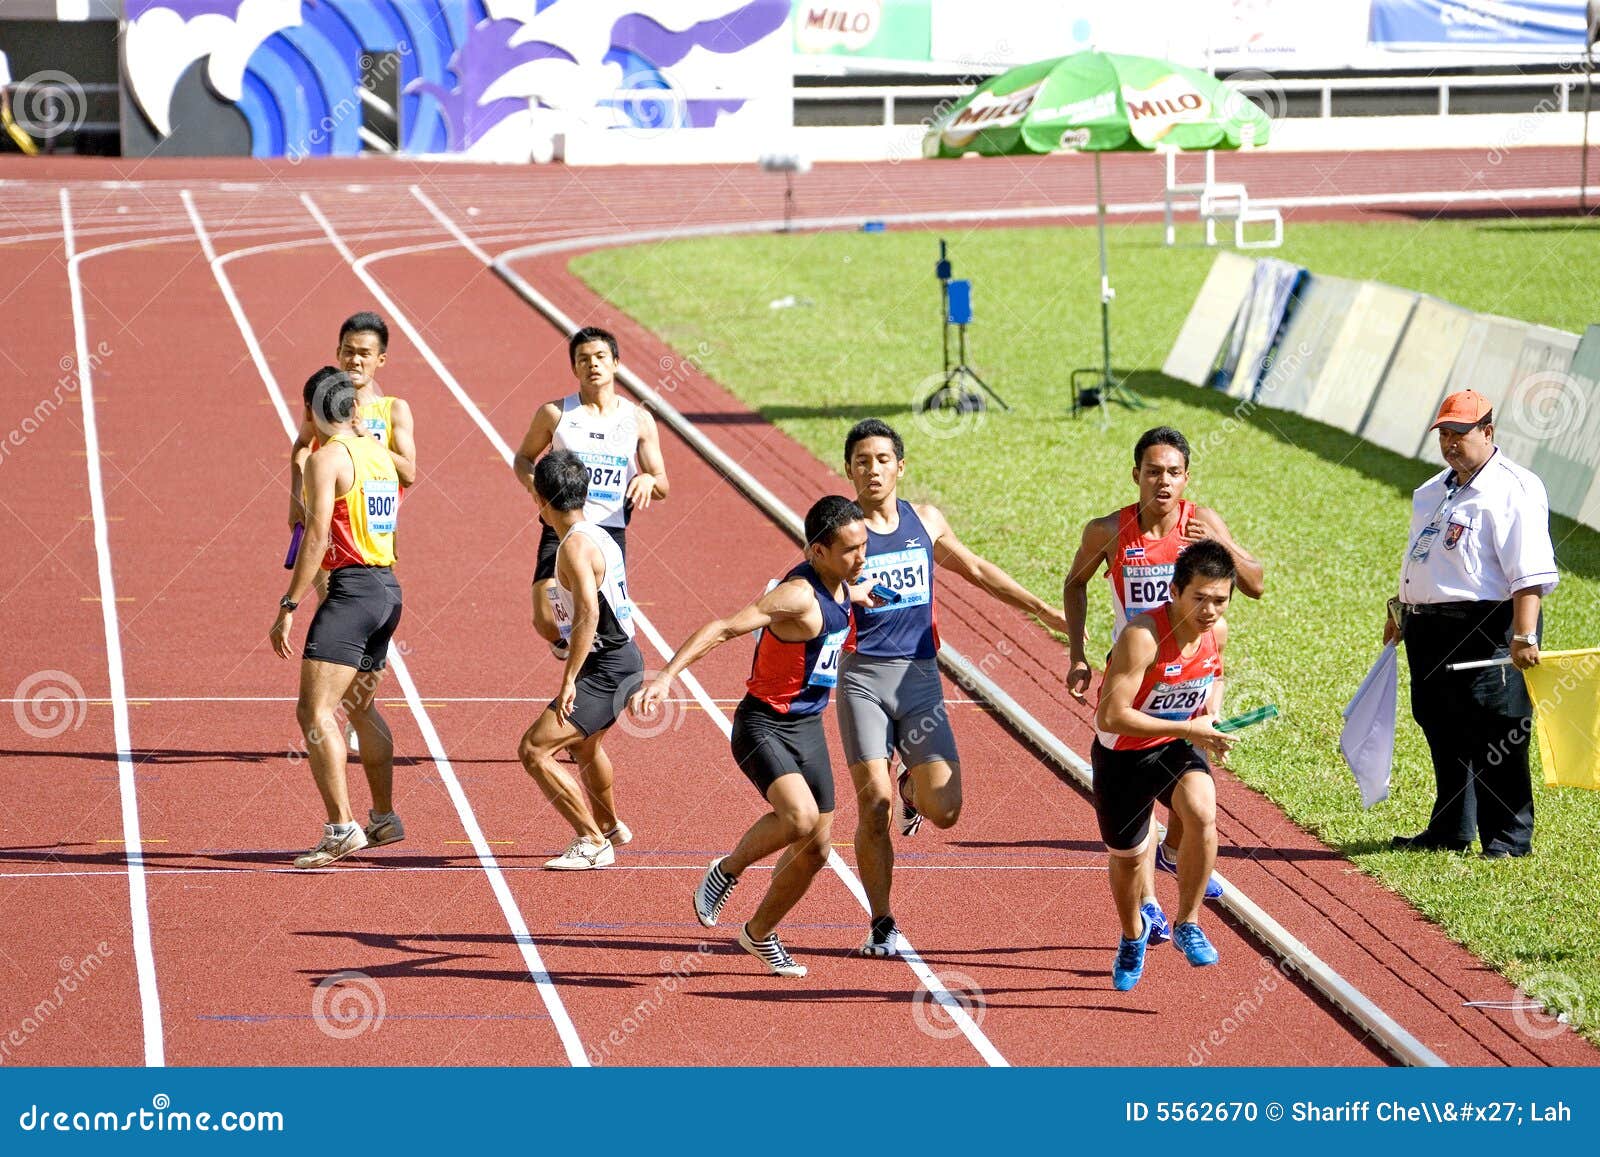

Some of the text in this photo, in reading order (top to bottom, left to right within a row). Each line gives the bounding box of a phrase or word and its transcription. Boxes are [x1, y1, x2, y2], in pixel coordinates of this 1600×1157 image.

[805, 8, 870, 33] MILO
[952, 96, 1035, 127] MILO
[1126, 93, 1203, 120] MILO
[1126, 565, 1175, 577] PETRONA
[1148, 688, 1207, 710] E0281
